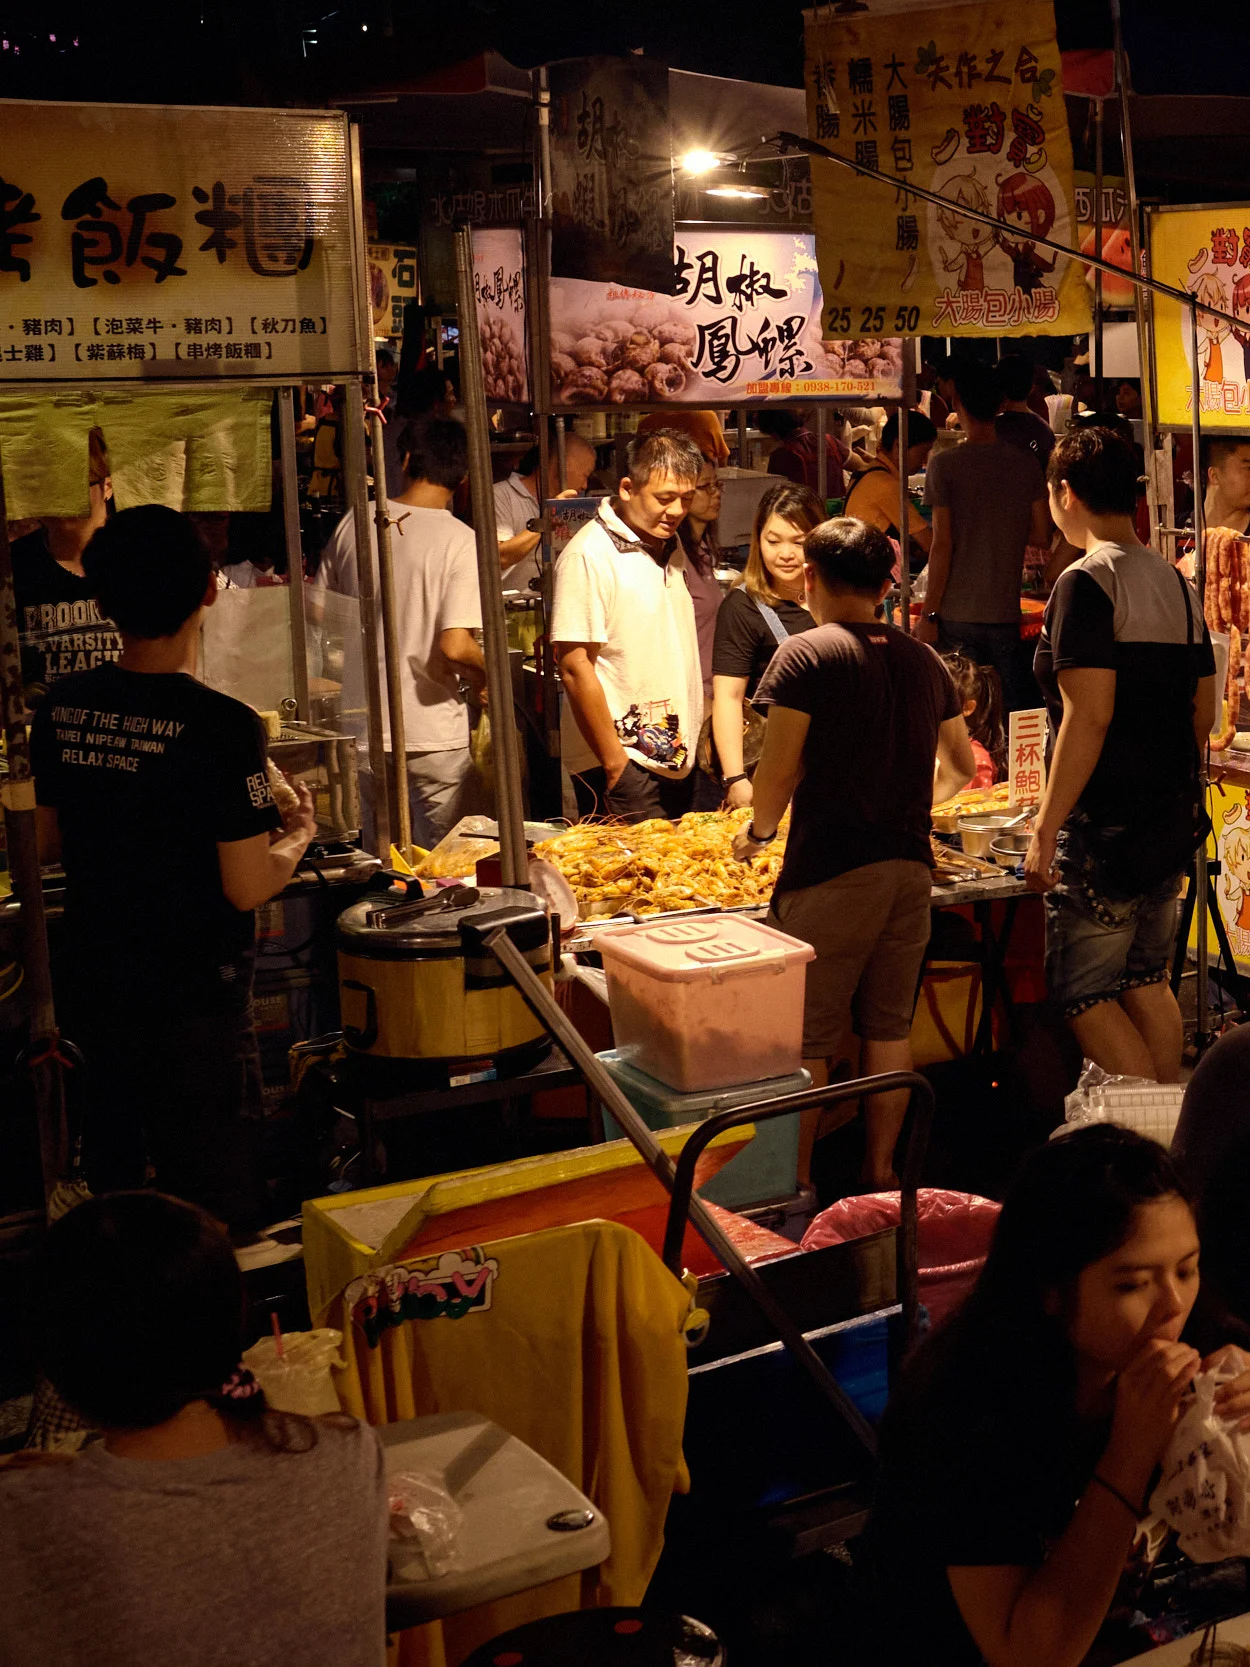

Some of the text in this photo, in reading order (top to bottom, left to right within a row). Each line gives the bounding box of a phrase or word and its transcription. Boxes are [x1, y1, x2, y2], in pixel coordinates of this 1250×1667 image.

[672, 247, 788, 312] 胡椒
[828, 305, 920, 333] 25 25 50
[933, 287, 1060, 328] 大腸包小腸
[690, 315, 817, 383] 鳳螺
[48, 631, 124, 652] VARSITY
[93, 711, 120, 730] THE
[123, 716, 150, 734] HIGH
[152, 718, 185, 739] WAY
[62, 749, 140, 772] RELAX SPACE
